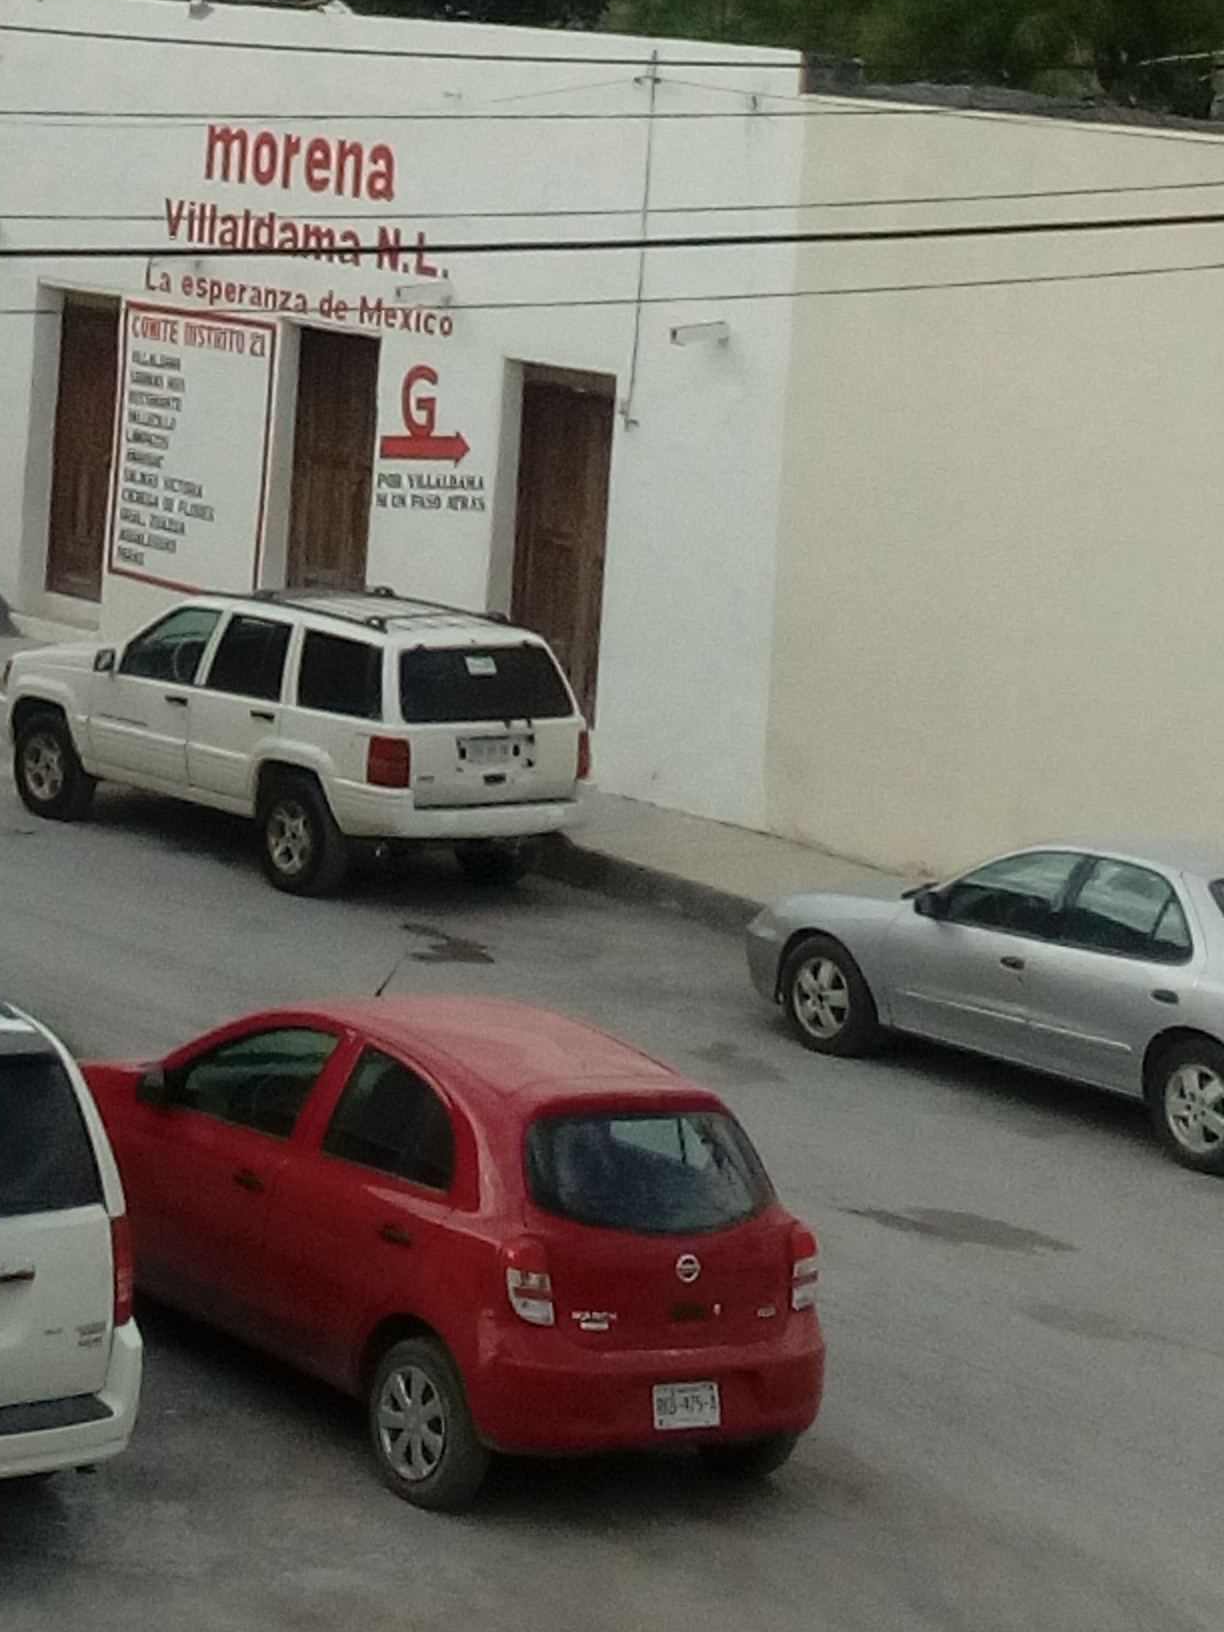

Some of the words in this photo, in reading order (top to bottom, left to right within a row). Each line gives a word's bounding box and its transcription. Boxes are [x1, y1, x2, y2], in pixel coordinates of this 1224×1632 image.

[204, 123, 395, 203] morena
[164, 197, 362, 267] Villaldama
[376, 225, 450, 279] N.L.
[145, 261, 172, 294] La
[180, 273, 309, 316] esperanza
[319, 289, 349, 321] de
[401, 364, 439, 437] G
